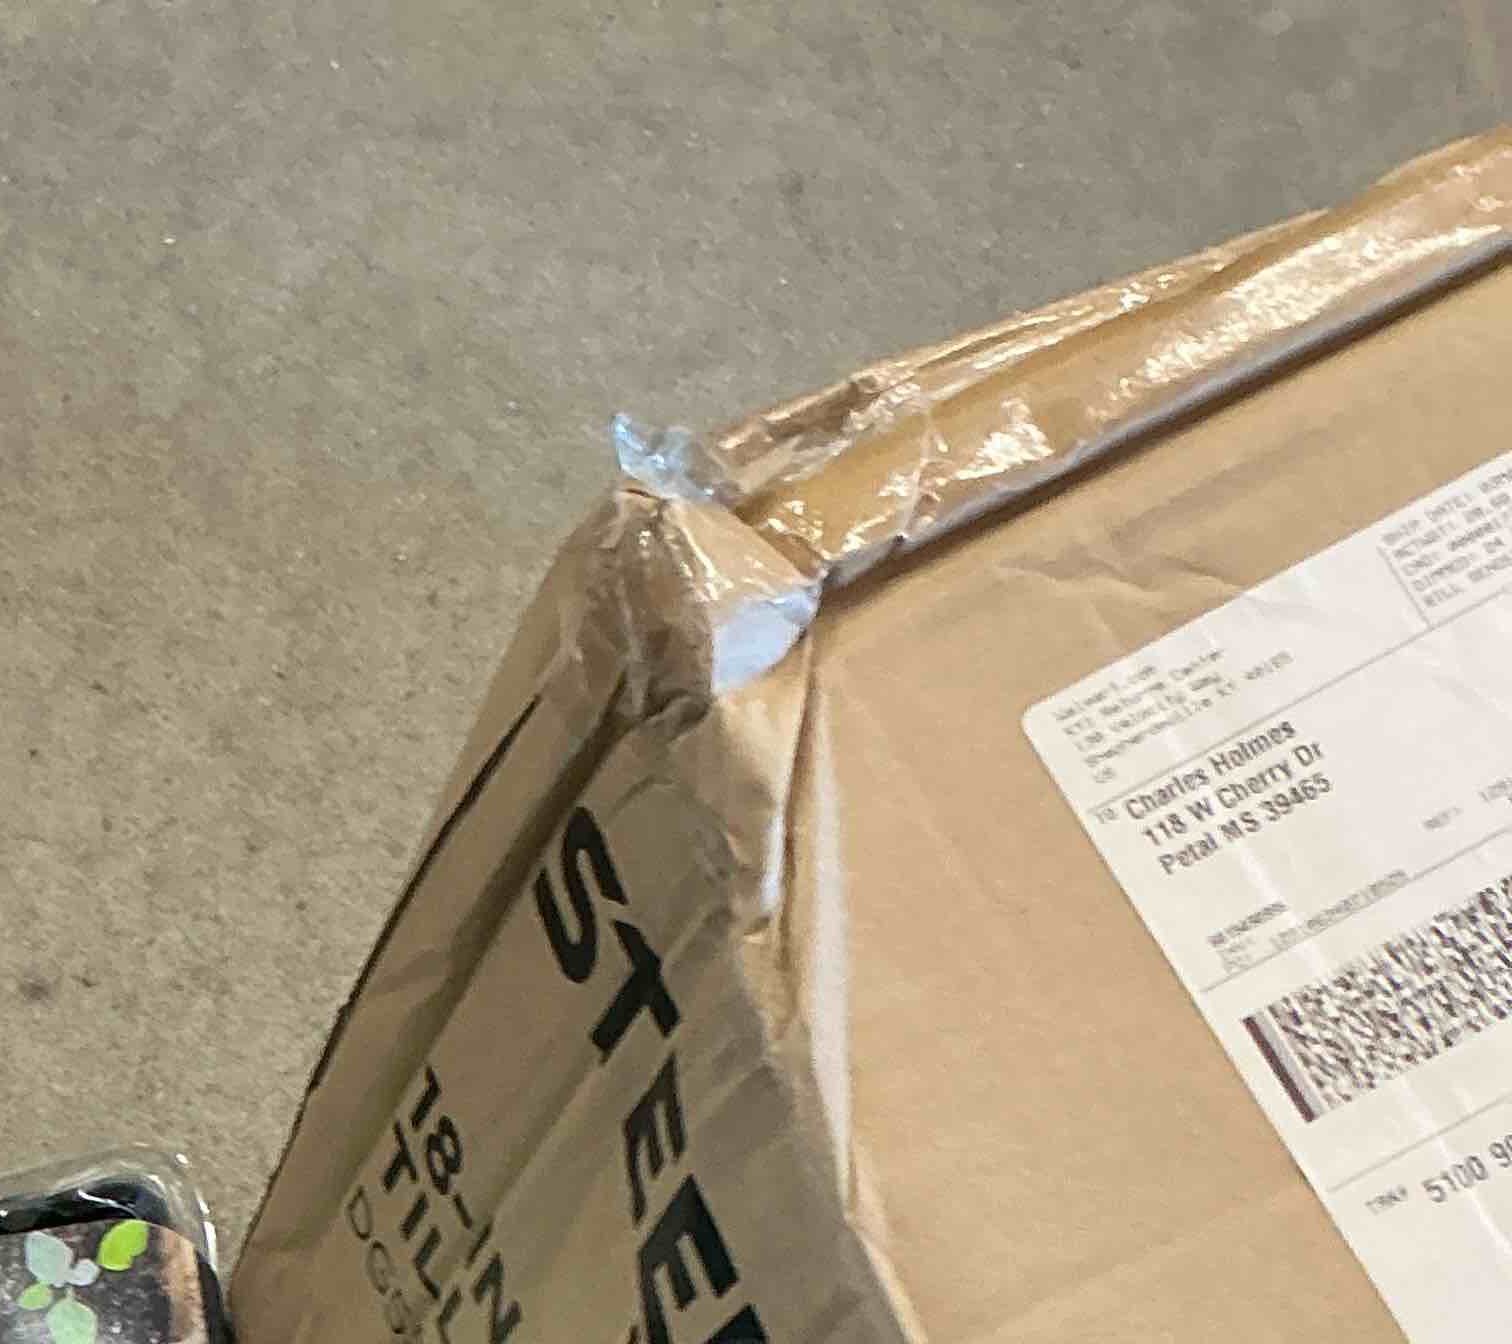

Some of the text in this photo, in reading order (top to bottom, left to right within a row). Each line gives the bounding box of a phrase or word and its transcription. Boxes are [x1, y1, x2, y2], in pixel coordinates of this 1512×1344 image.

[1122, 760, 1211, 824] Charles
[1208, 715, 1297, 778] Holmes
[1141, 736, 1327, 850] 118 W Cherry Dr
[1156, 767, 1334, 877] Petal MS 39465
[1421, 1155, 1488, 1204] 5100
